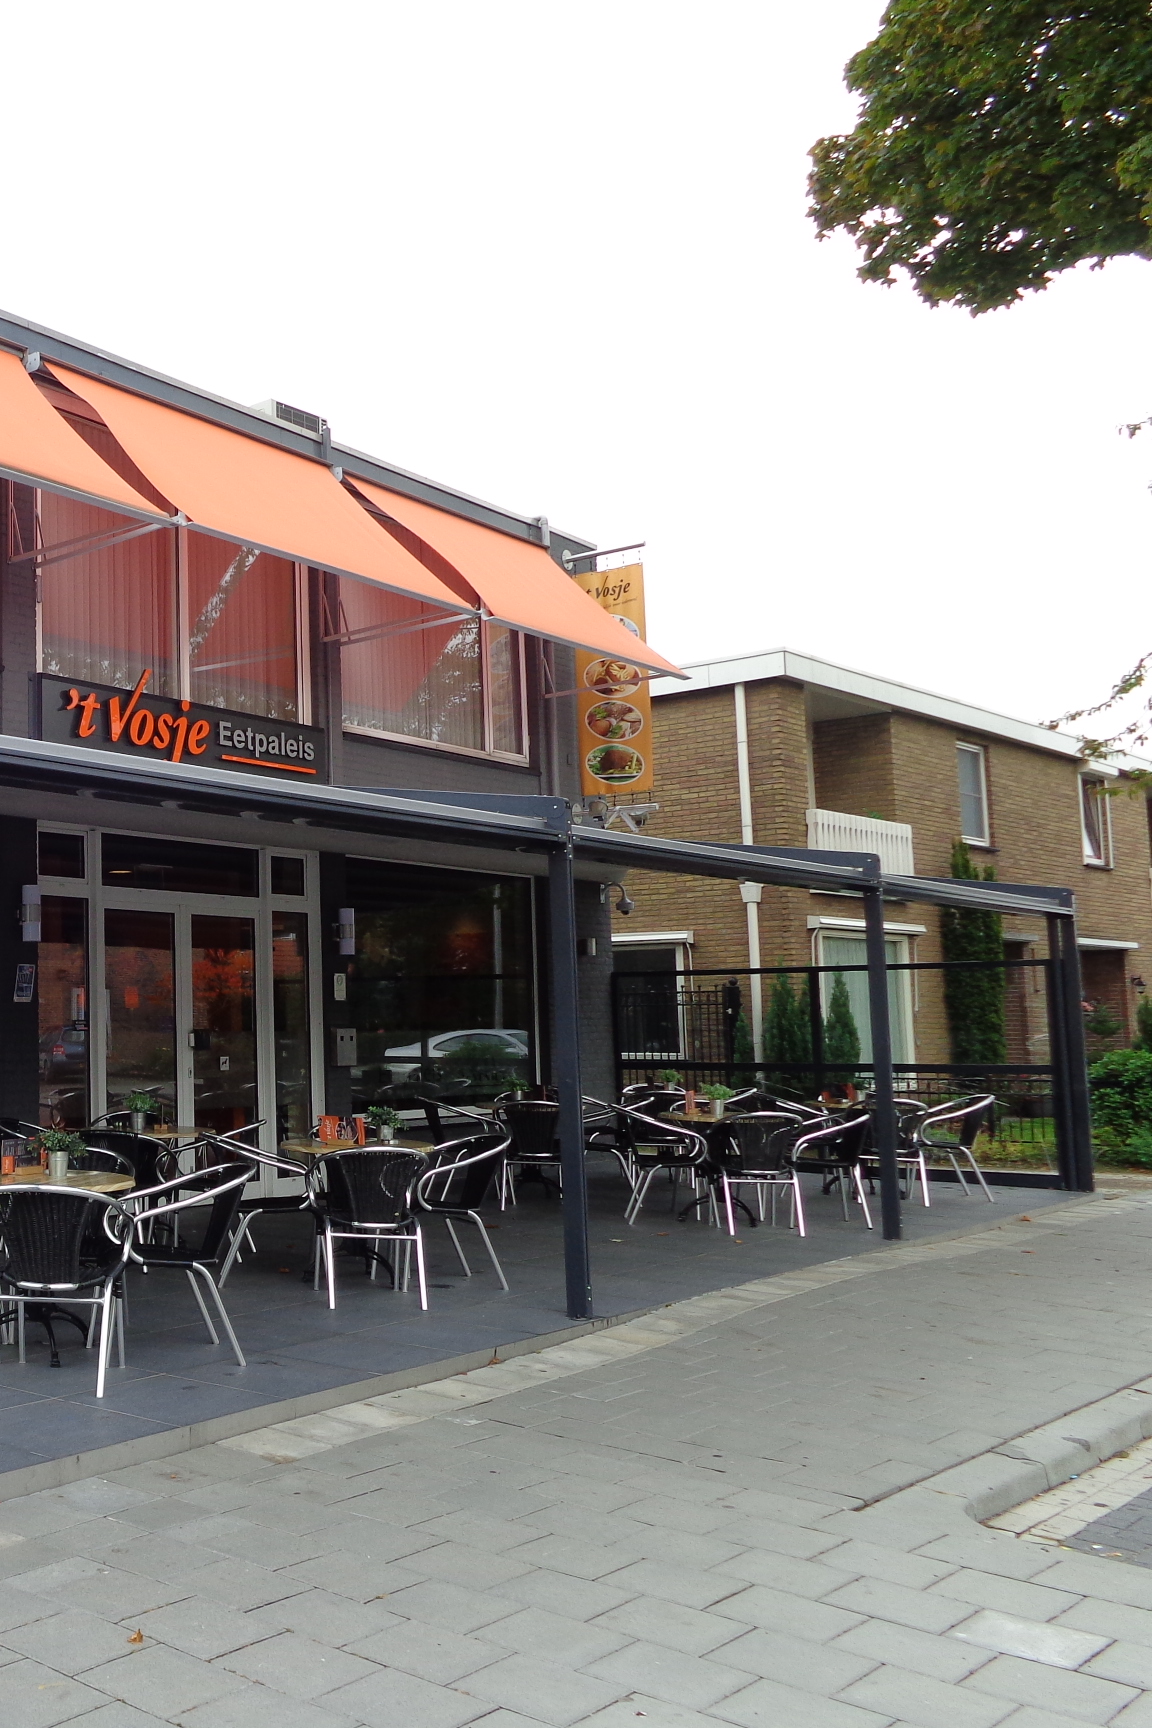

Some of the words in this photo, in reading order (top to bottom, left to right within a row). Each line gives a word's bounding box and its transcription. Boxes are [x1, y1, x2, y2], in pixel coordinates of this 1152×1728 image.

[595, 575, 631, 601] Vosje
[66, 688, 101, 738] 't
[108, 668, 211, 763] Vosje
[218, 720, 316, 761] Eetpaleis
